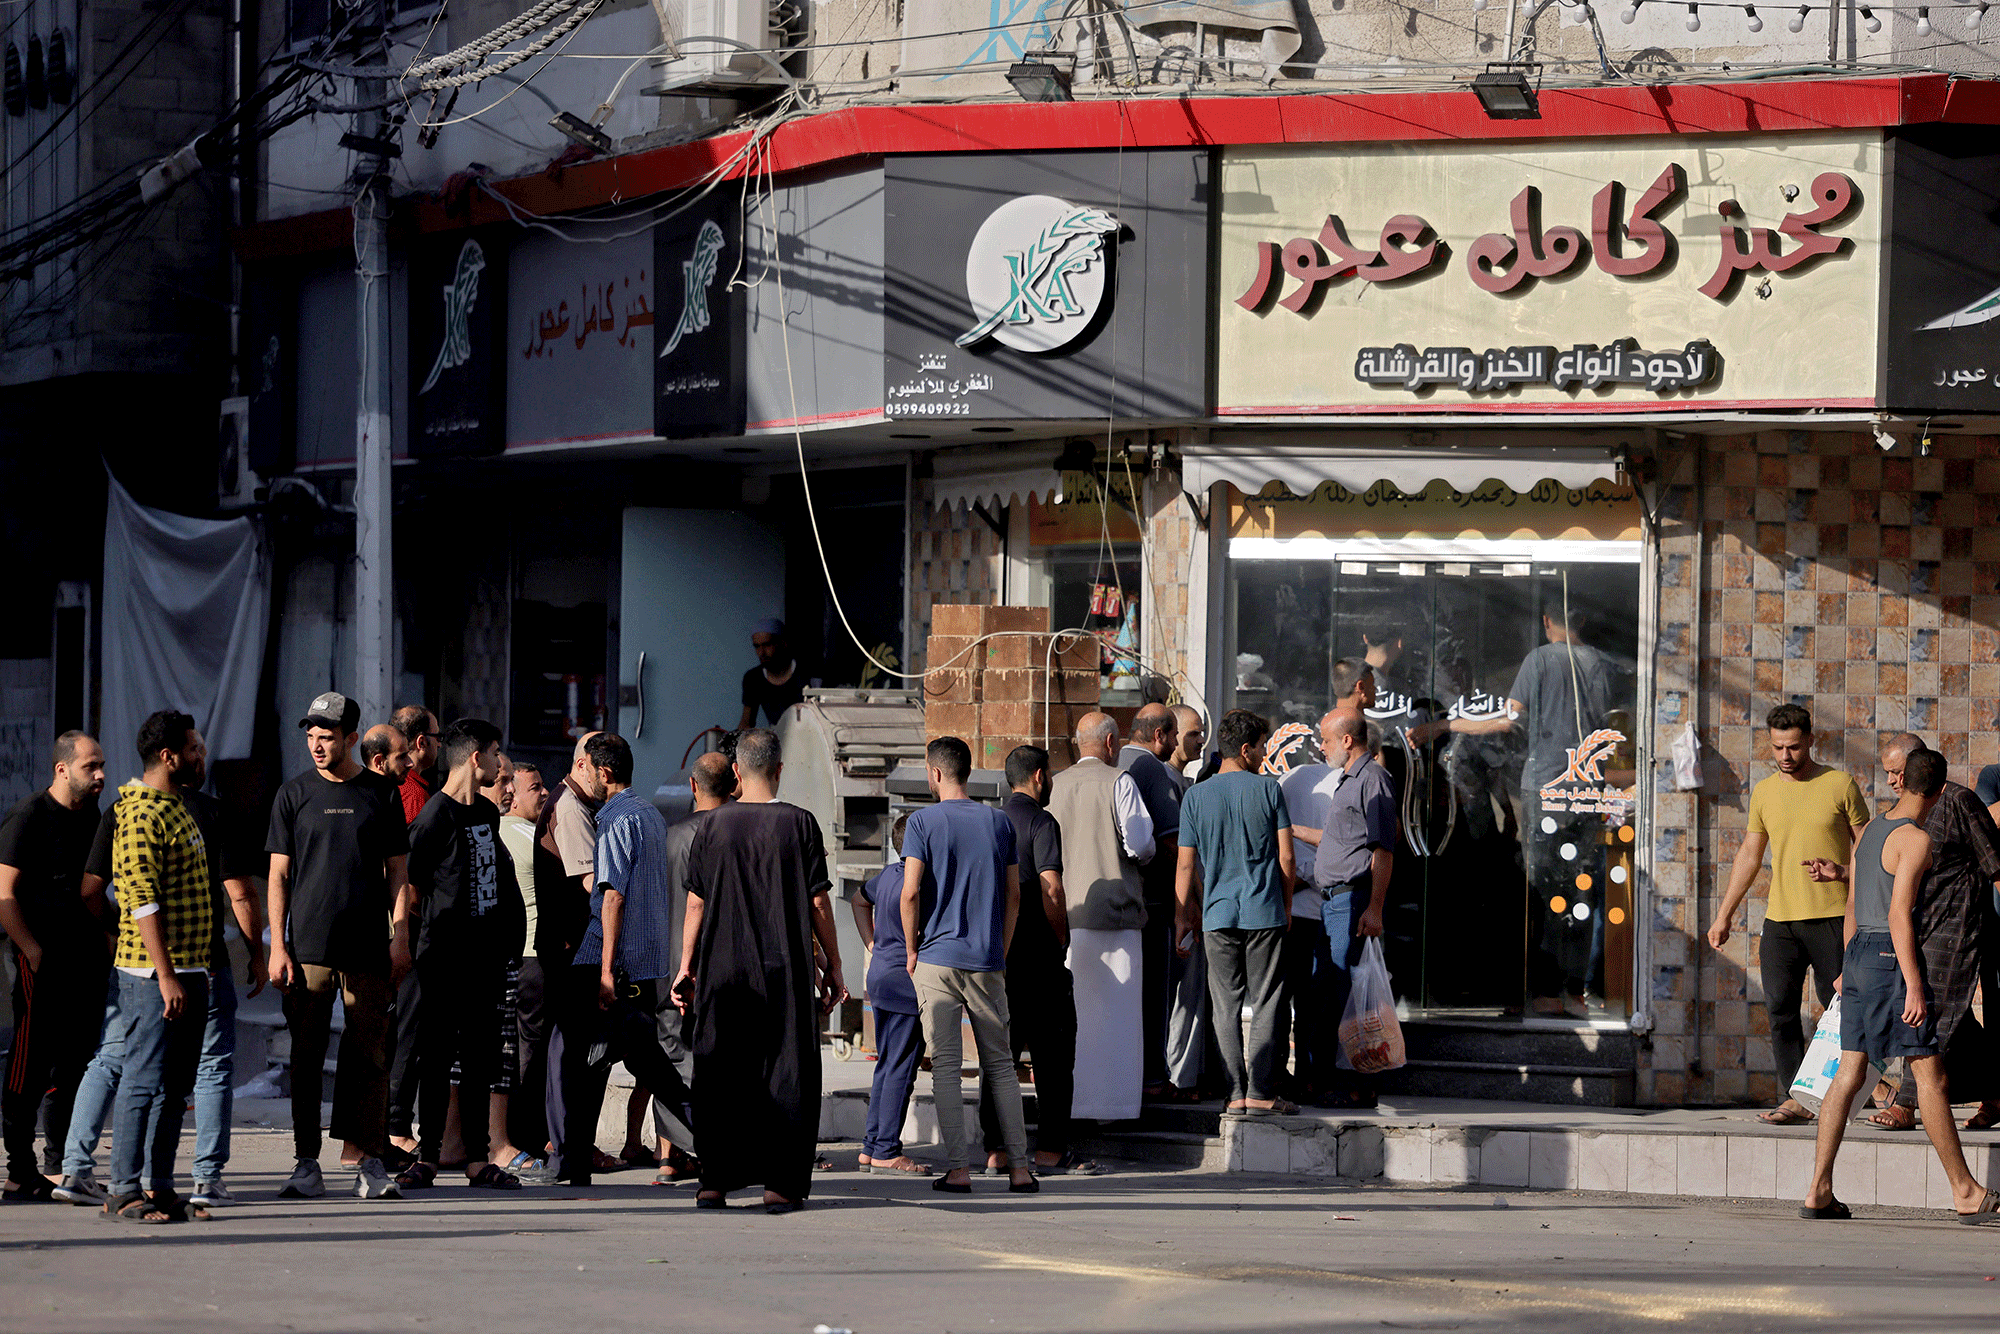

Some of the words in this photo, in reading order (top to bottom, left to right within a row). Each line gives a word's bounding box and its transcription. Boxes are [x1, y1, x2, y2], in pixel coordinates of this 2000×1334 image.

[1466, 162, 1686, 296] كامل
[575, 281, 615, 351] كامل
[617, 269, 655, 348] خبز
[523, 301, 570, 360] عجور
[1359, 349, 1476, 387] والقرشلة
[1481, 351, 1542, 387] الخبز
[1554, 344, 1622, 386] أنواع
[1629, 346, 1703, 387] لأجود
[1933, 368, 1987, 388] عجور
[885, 403, 970, 415] 0599409922
[1530, 479, 1560, 505] الله
[1567, 486, 1633, 507] سبحان
[1567, 786, 1601, 801] كامل
[1569, 802, 1595, 814] Ajour
[1595, 803, 1625, 814] Bakery
[1602, 788, 1633, 802] مخبز
[465, 826, 474, 845] FOR
[471, 823, 498, 916] DIESEL
